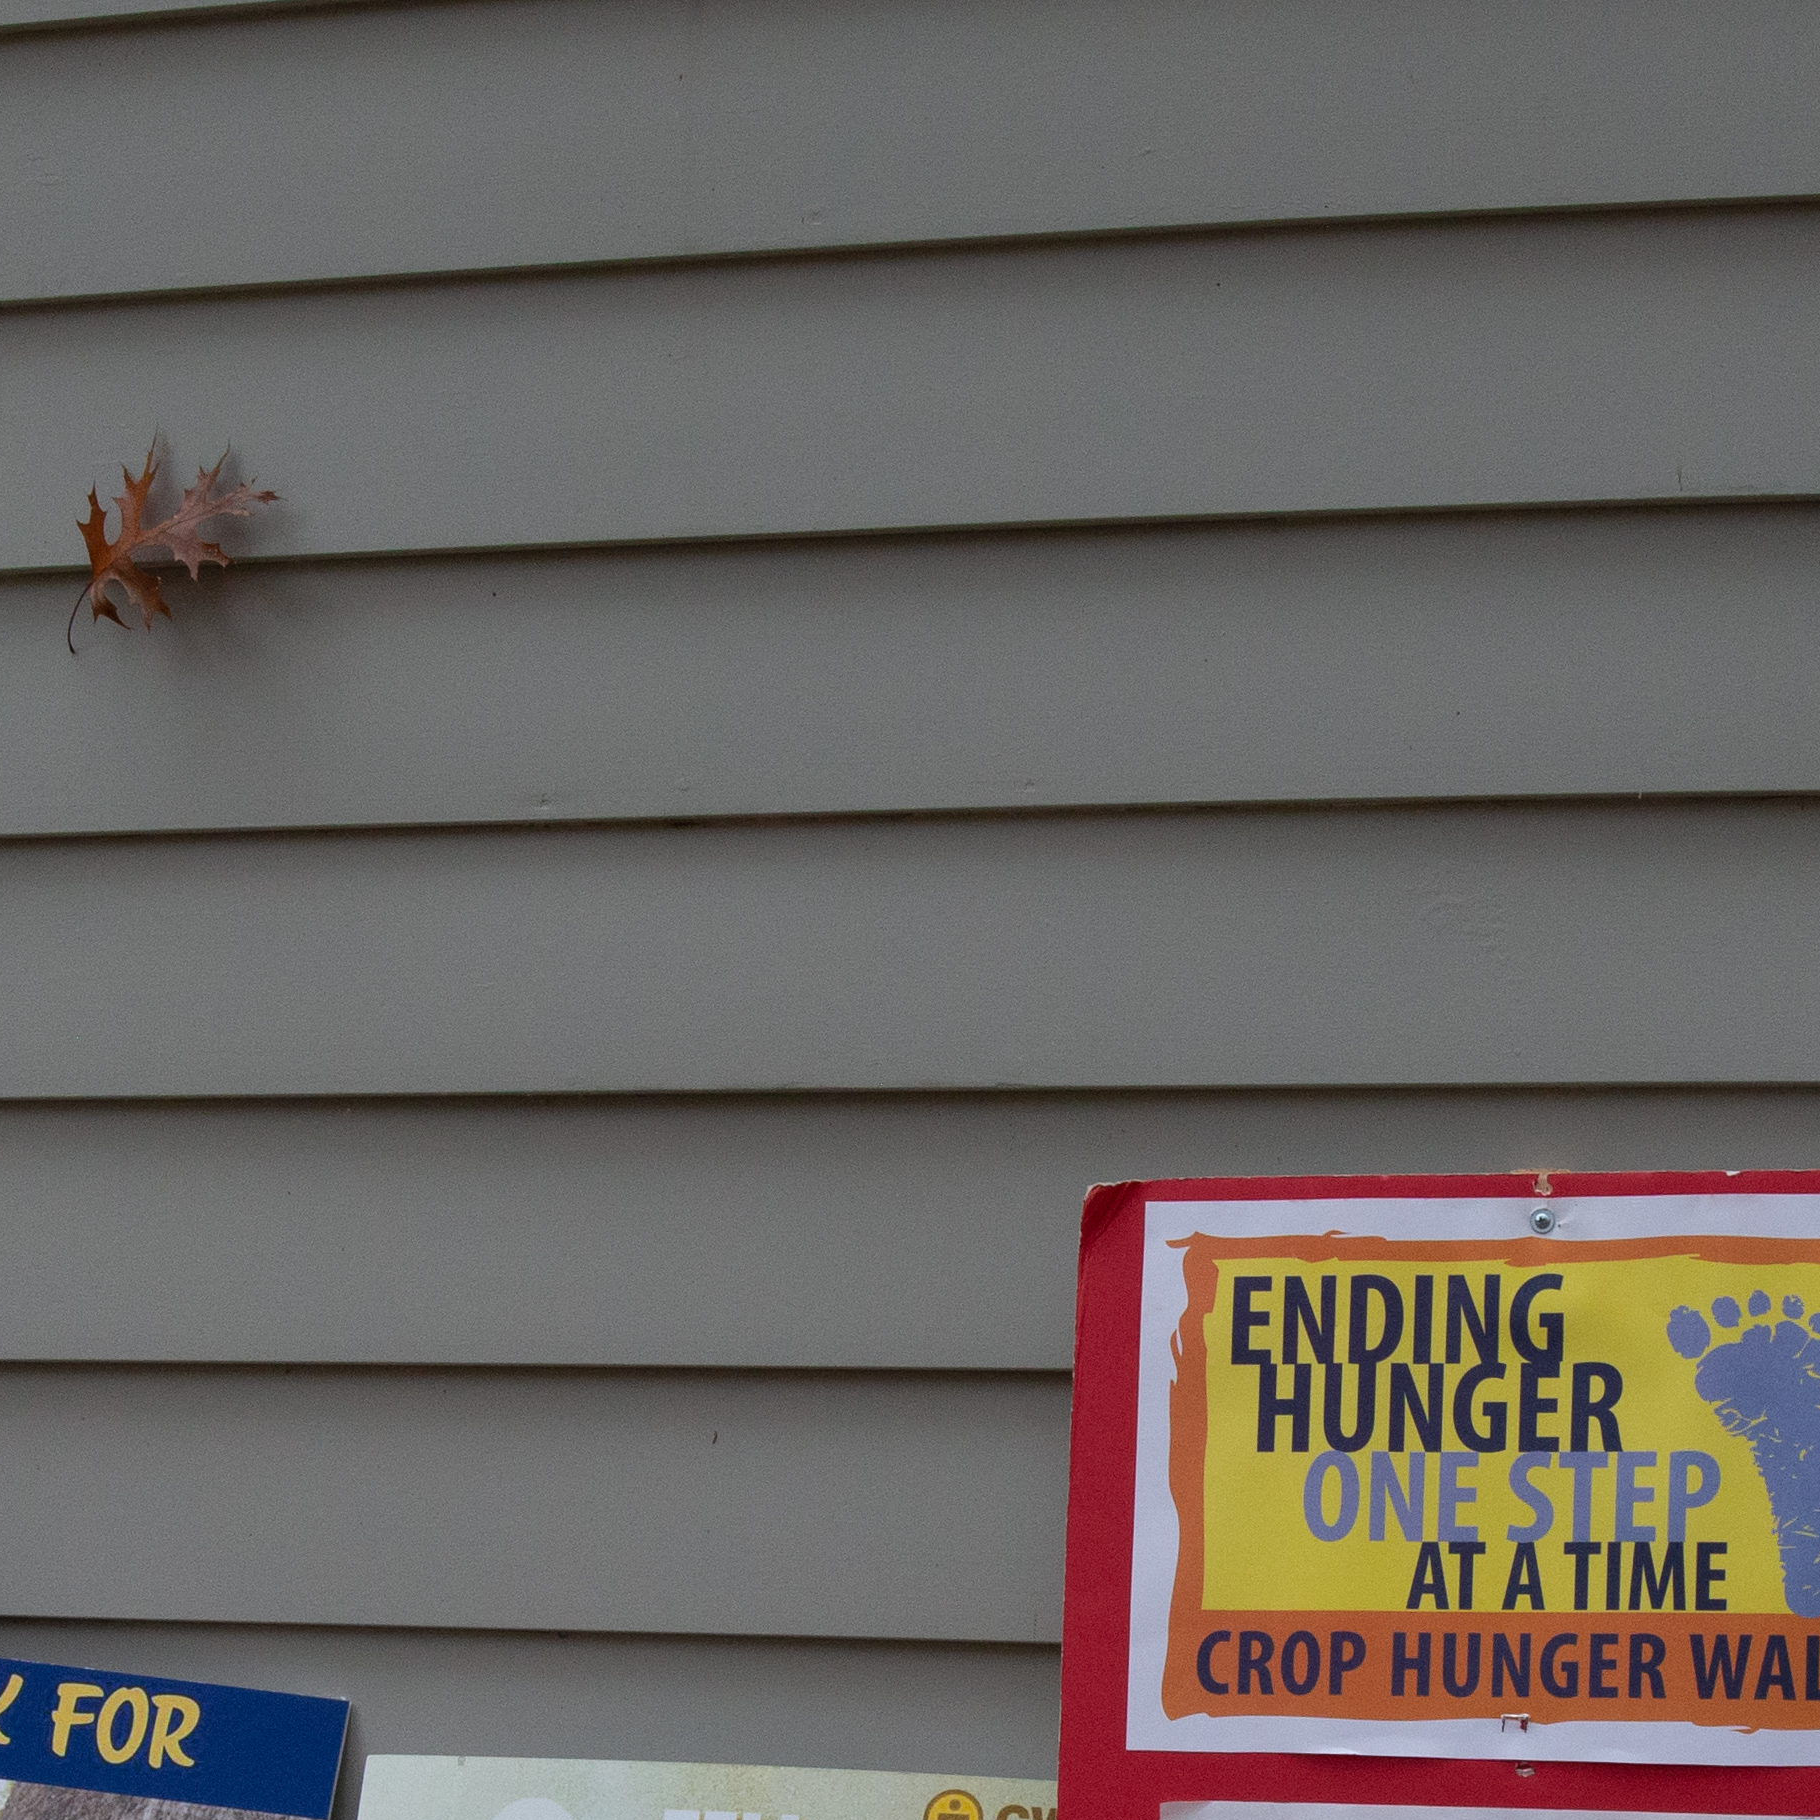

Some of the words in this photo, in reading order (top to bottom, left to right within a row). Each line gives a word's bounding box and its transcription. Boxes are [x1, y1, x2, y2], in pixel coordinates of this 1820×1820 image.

[1231, 1272, 1565, 1367] ENDING
[1255, 1361, 1625, 1455] HUNGER
[1303, 1449, 1479, 1545] ONE
[1507, 1449, 1722, 1545] STEP
[1406, 1541, 1486, 1611] AT
[1500, 1541, 1547, 1611] A
[1563, 1541, 1728, 1612] TIME
[1195, 1629, 1368, 1697] CROP
[1390, 1630, 1667, 1701] HUNGER
[51, 1681, 201, 1769] FOR
